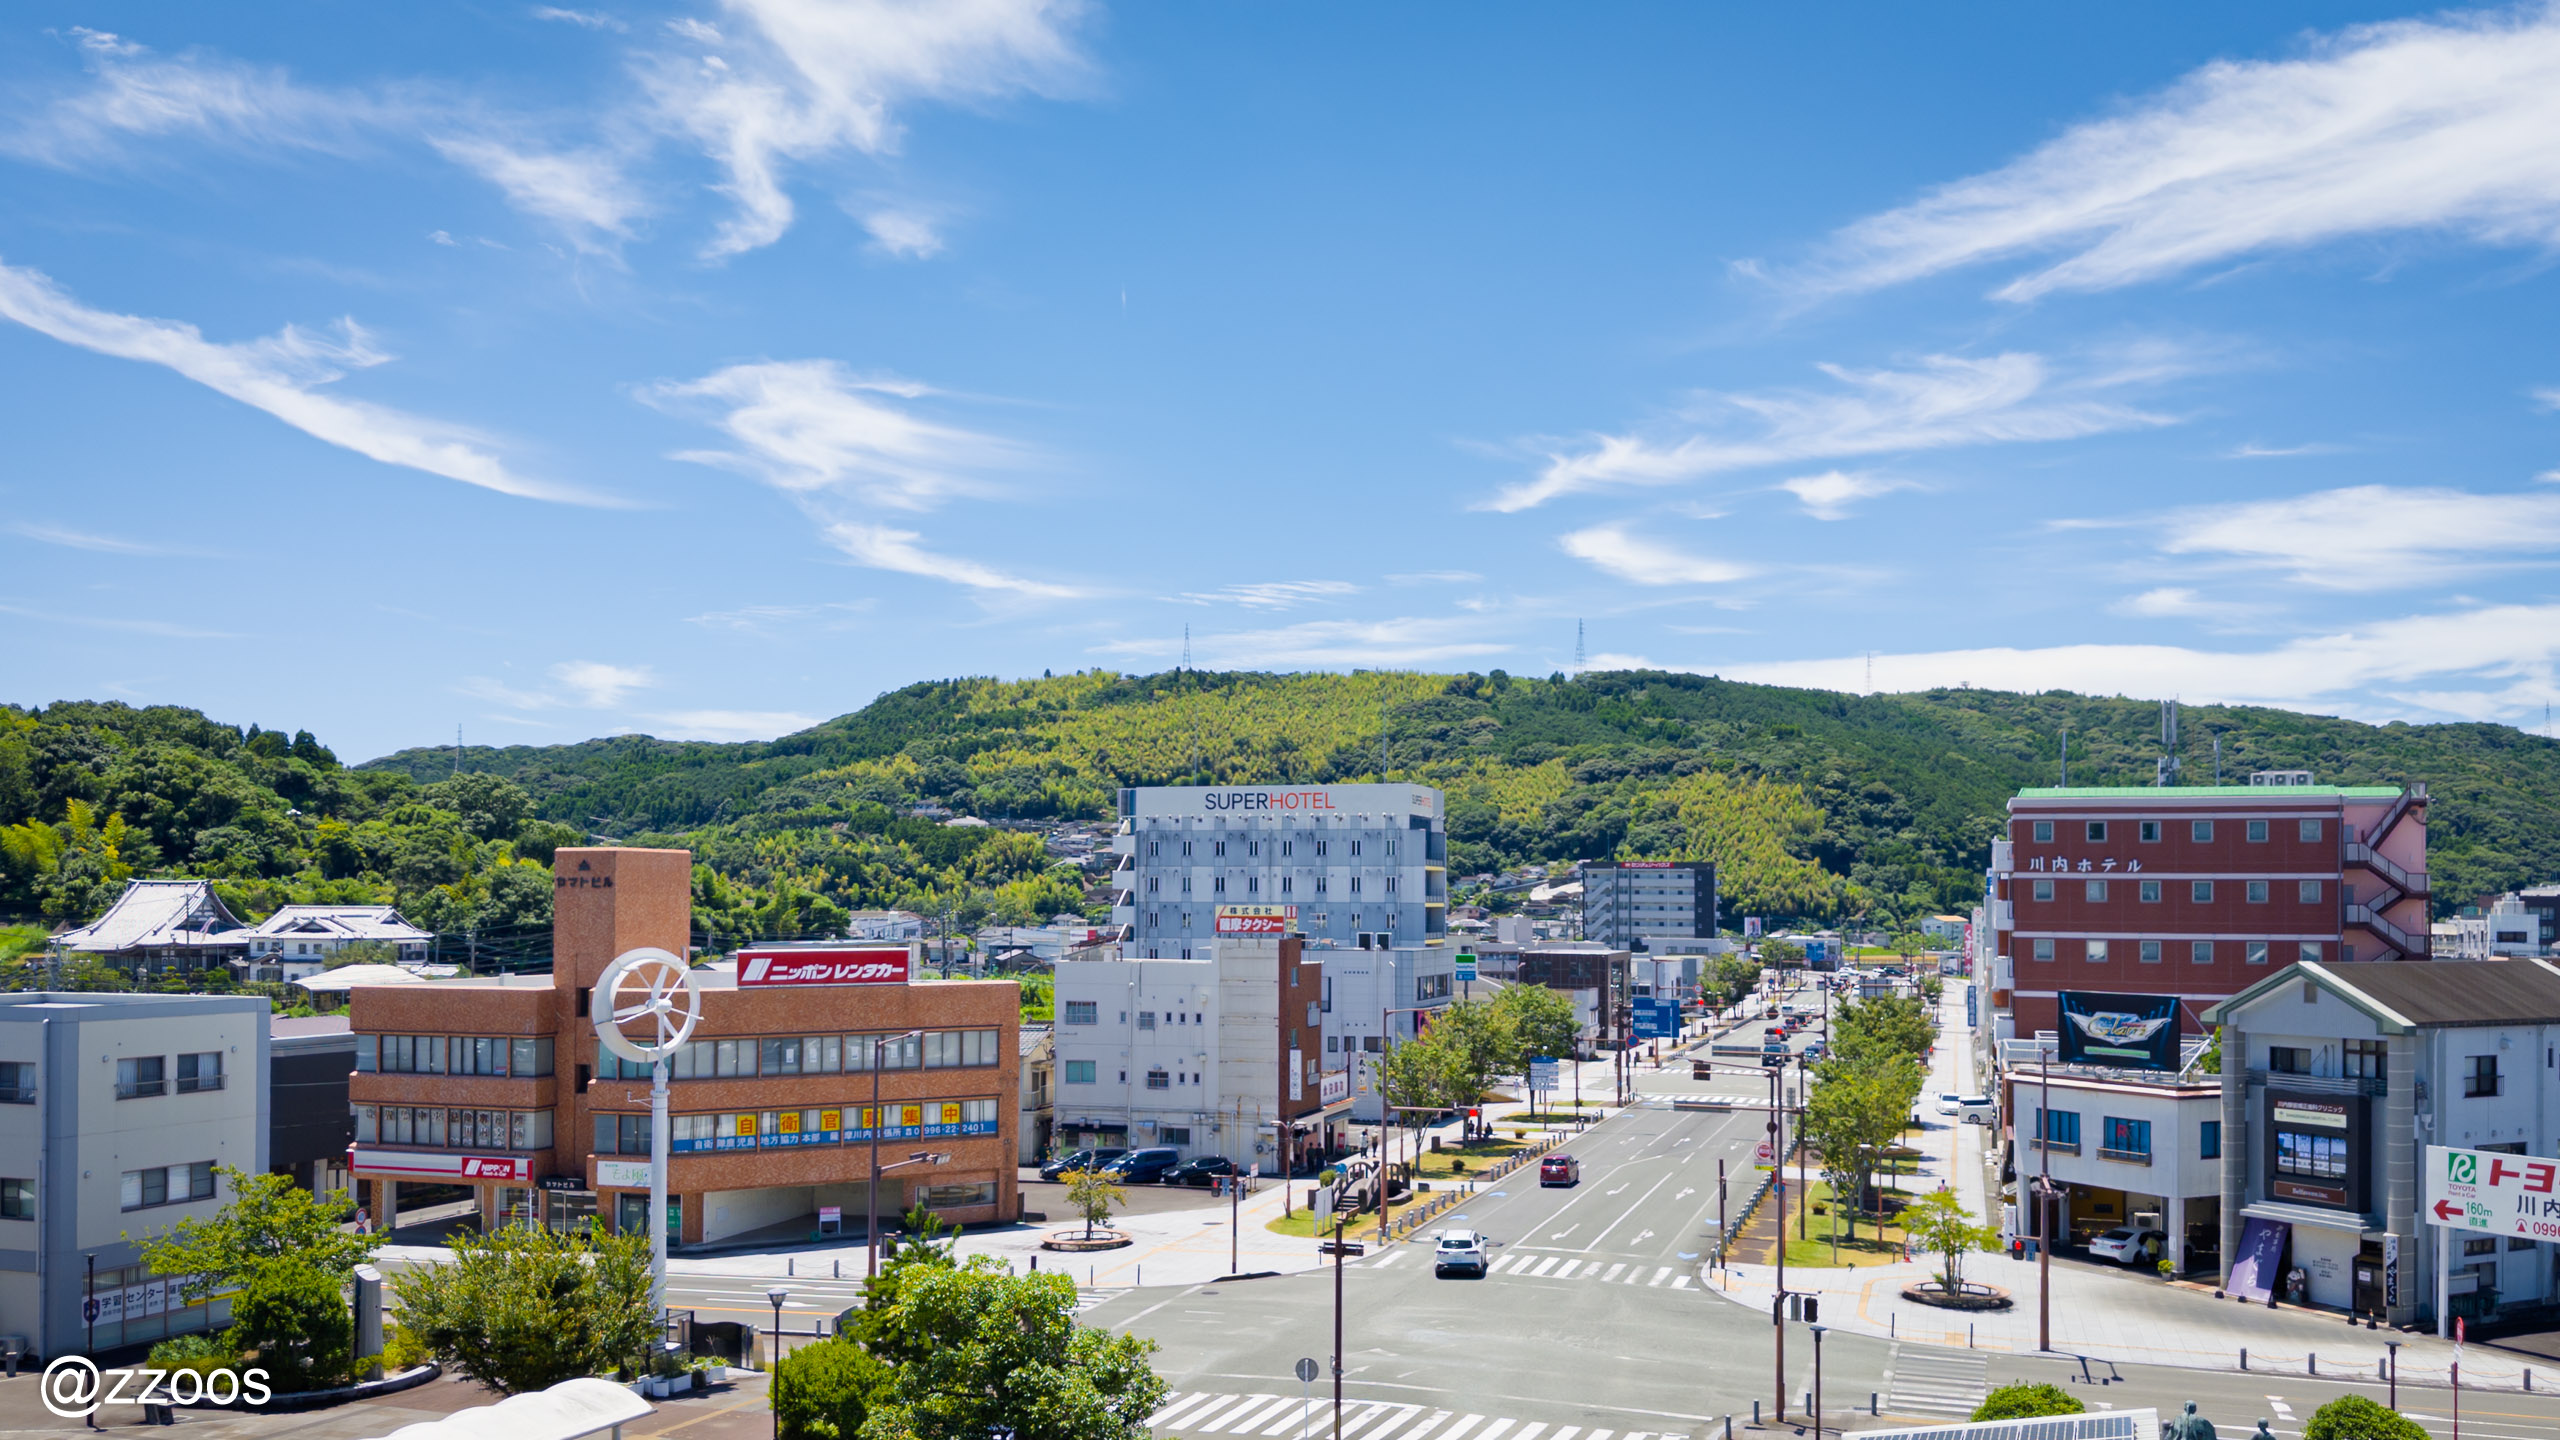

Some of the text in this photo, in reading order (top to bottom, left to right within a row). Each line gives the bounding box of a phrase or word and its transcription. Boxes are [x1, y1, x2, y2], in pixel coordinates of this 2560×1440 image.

[2029, 855, 2143, 873] 川内ホテル
[1230, 906, 1272, 915] 株式会社
[481, 1163, 511, 1173] NIPPON
[2489, 1158, 2560, 1193] トヨ
[2448, 1183, 2477, 1192] TOYOTA
[2465, 1201, 2493, 1217] 160m
[2517, 1194, 2560, 1219] 川内
[2469, 1216, 2489, 1228] 直進
[101, 1288, 164, 1309] 学習センター
